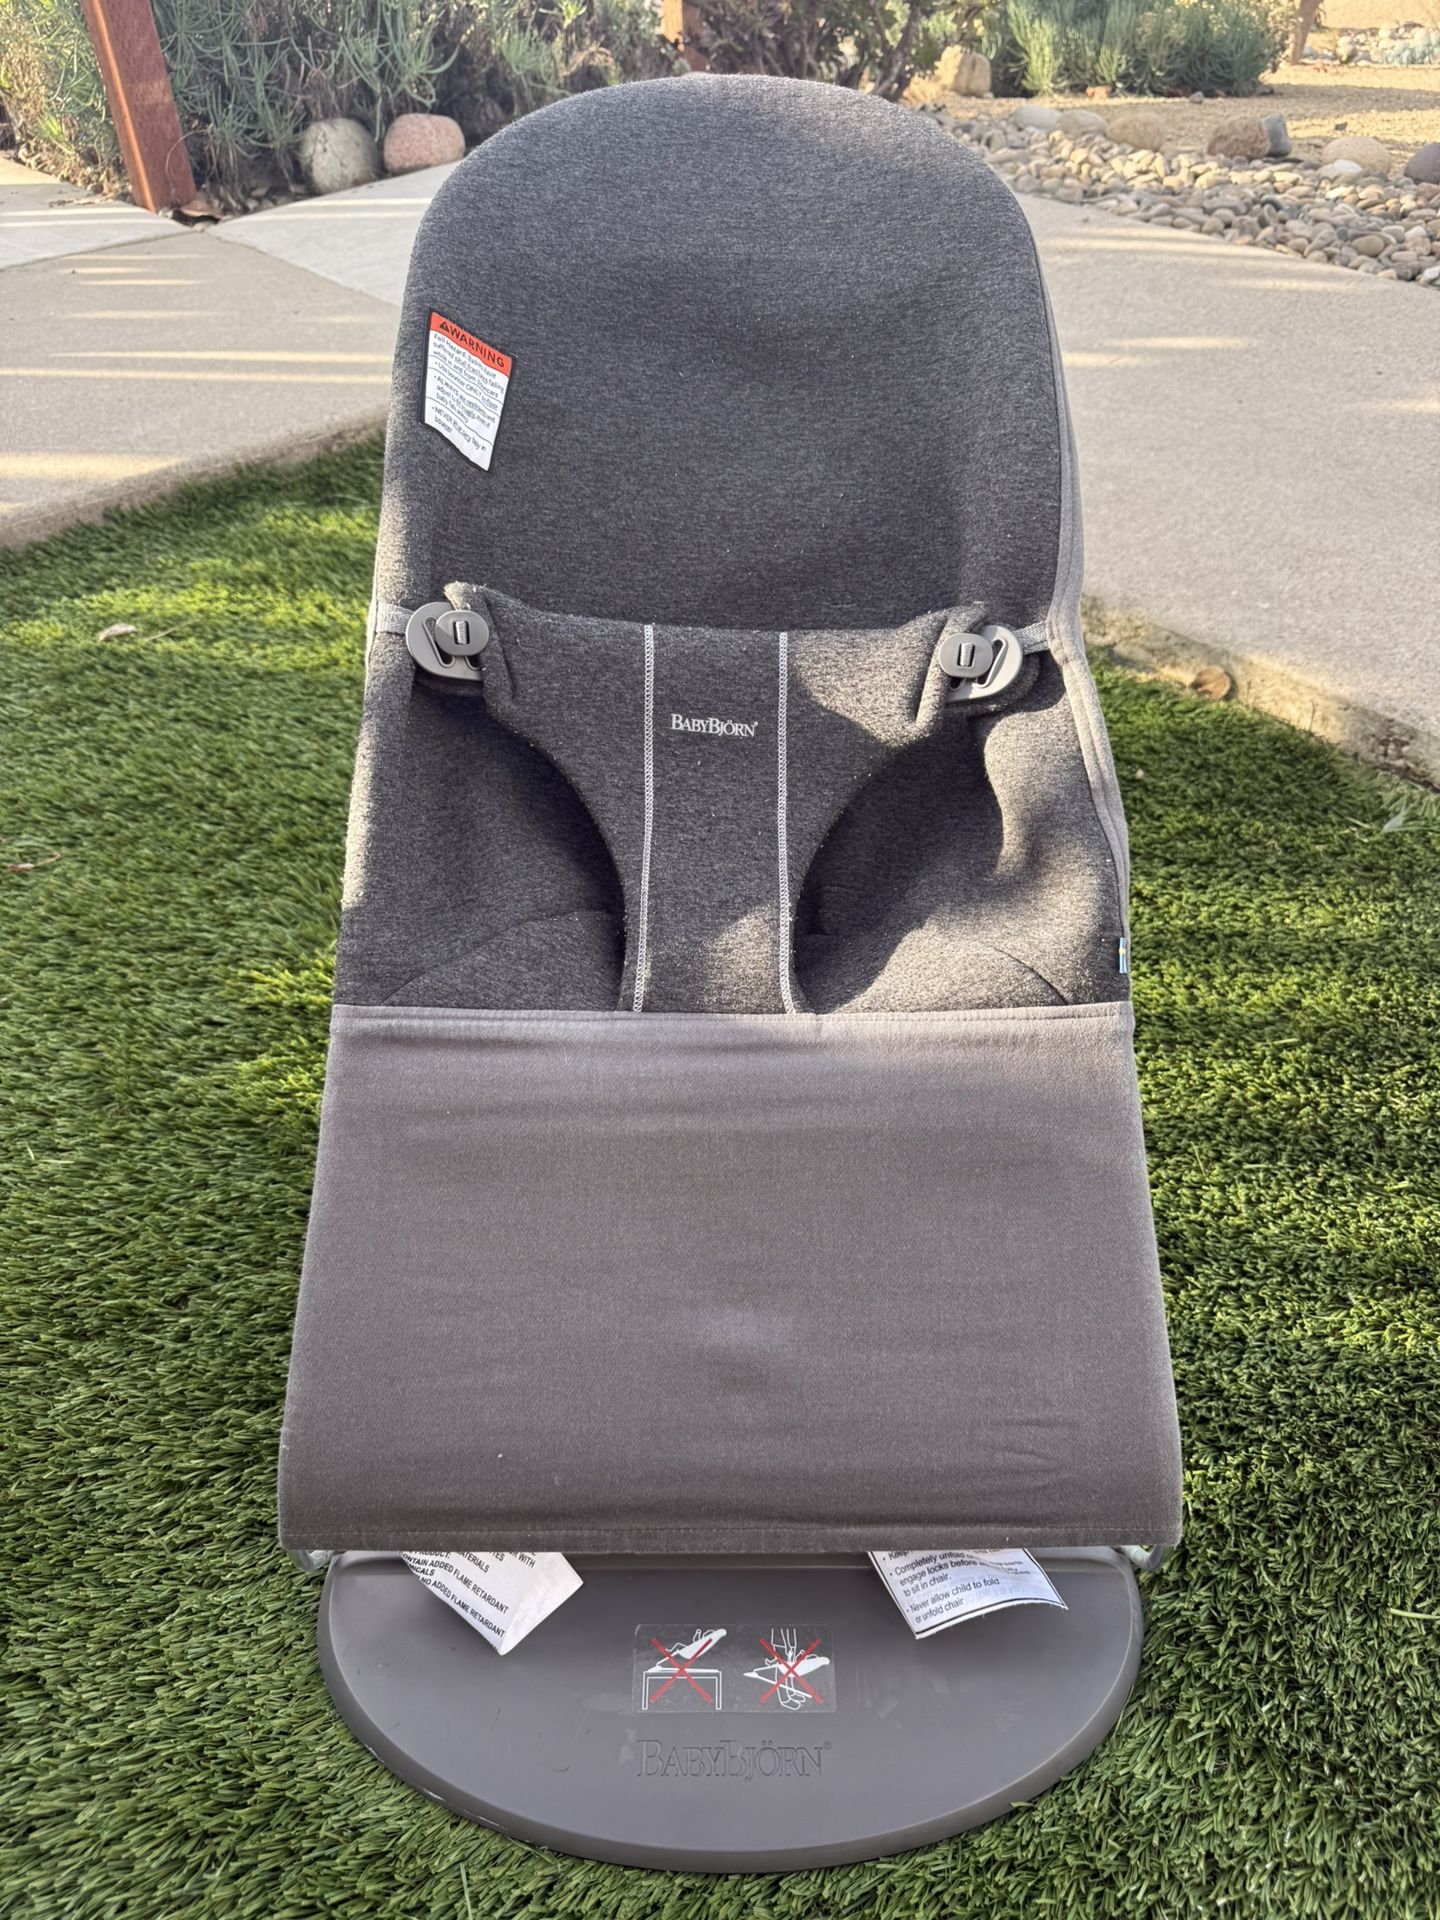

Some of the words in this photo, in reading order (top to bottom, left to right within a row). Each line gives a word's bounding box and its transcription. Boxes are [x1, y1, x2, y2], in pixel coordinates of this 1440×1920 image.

[450, 325, 505, 368] WARNING
[671, 713, 755, 737] BABYBJÖRN
[407, 1563, 436, 1576] MICALS
[459, 1551, 490, 1573] ATERIALS
[518, 1553, 536, 1568] WITH
[895, 1554, 938, 1575] Completely
[939, 1551, 966, 1560] unfold
[900, 1570, 926, 1586] engage
[927, 1562, 949, 1575] locks
[950, 1559, 978, 1568] before
[429, 1560, 454, 1573] ADDED
[453, 1568, 473, 1589] FLAME
[471, 1584, 509, 1614] RETARDANT
[910, 1599, 929, 1613] Never
[930, 1590, 950, 1604] allow
[951, 1582, 972, 1596] child
[972, 1581, 983, 1589] to
[983, 1577, 1000, 1587] fold
[911, 1584, 920, 1594] sit
[921, 1581, 928, 1590] in
[929, 1573, 952, 1586] chair.
[421, 1577, 431, 1585] NO
[431, 1581, 452, 1598] ADDED
[450, 1594, 471, 1613] FLAME
[469, 1609, 505, 1638] RETARDANT
[915, 1615, 924, 1623] or
[921, 1605, 944, 1621] unfold
[944, 1598, 964, 1611] chair
[637, 1739, 824, 1782] BABYBJÖRN
